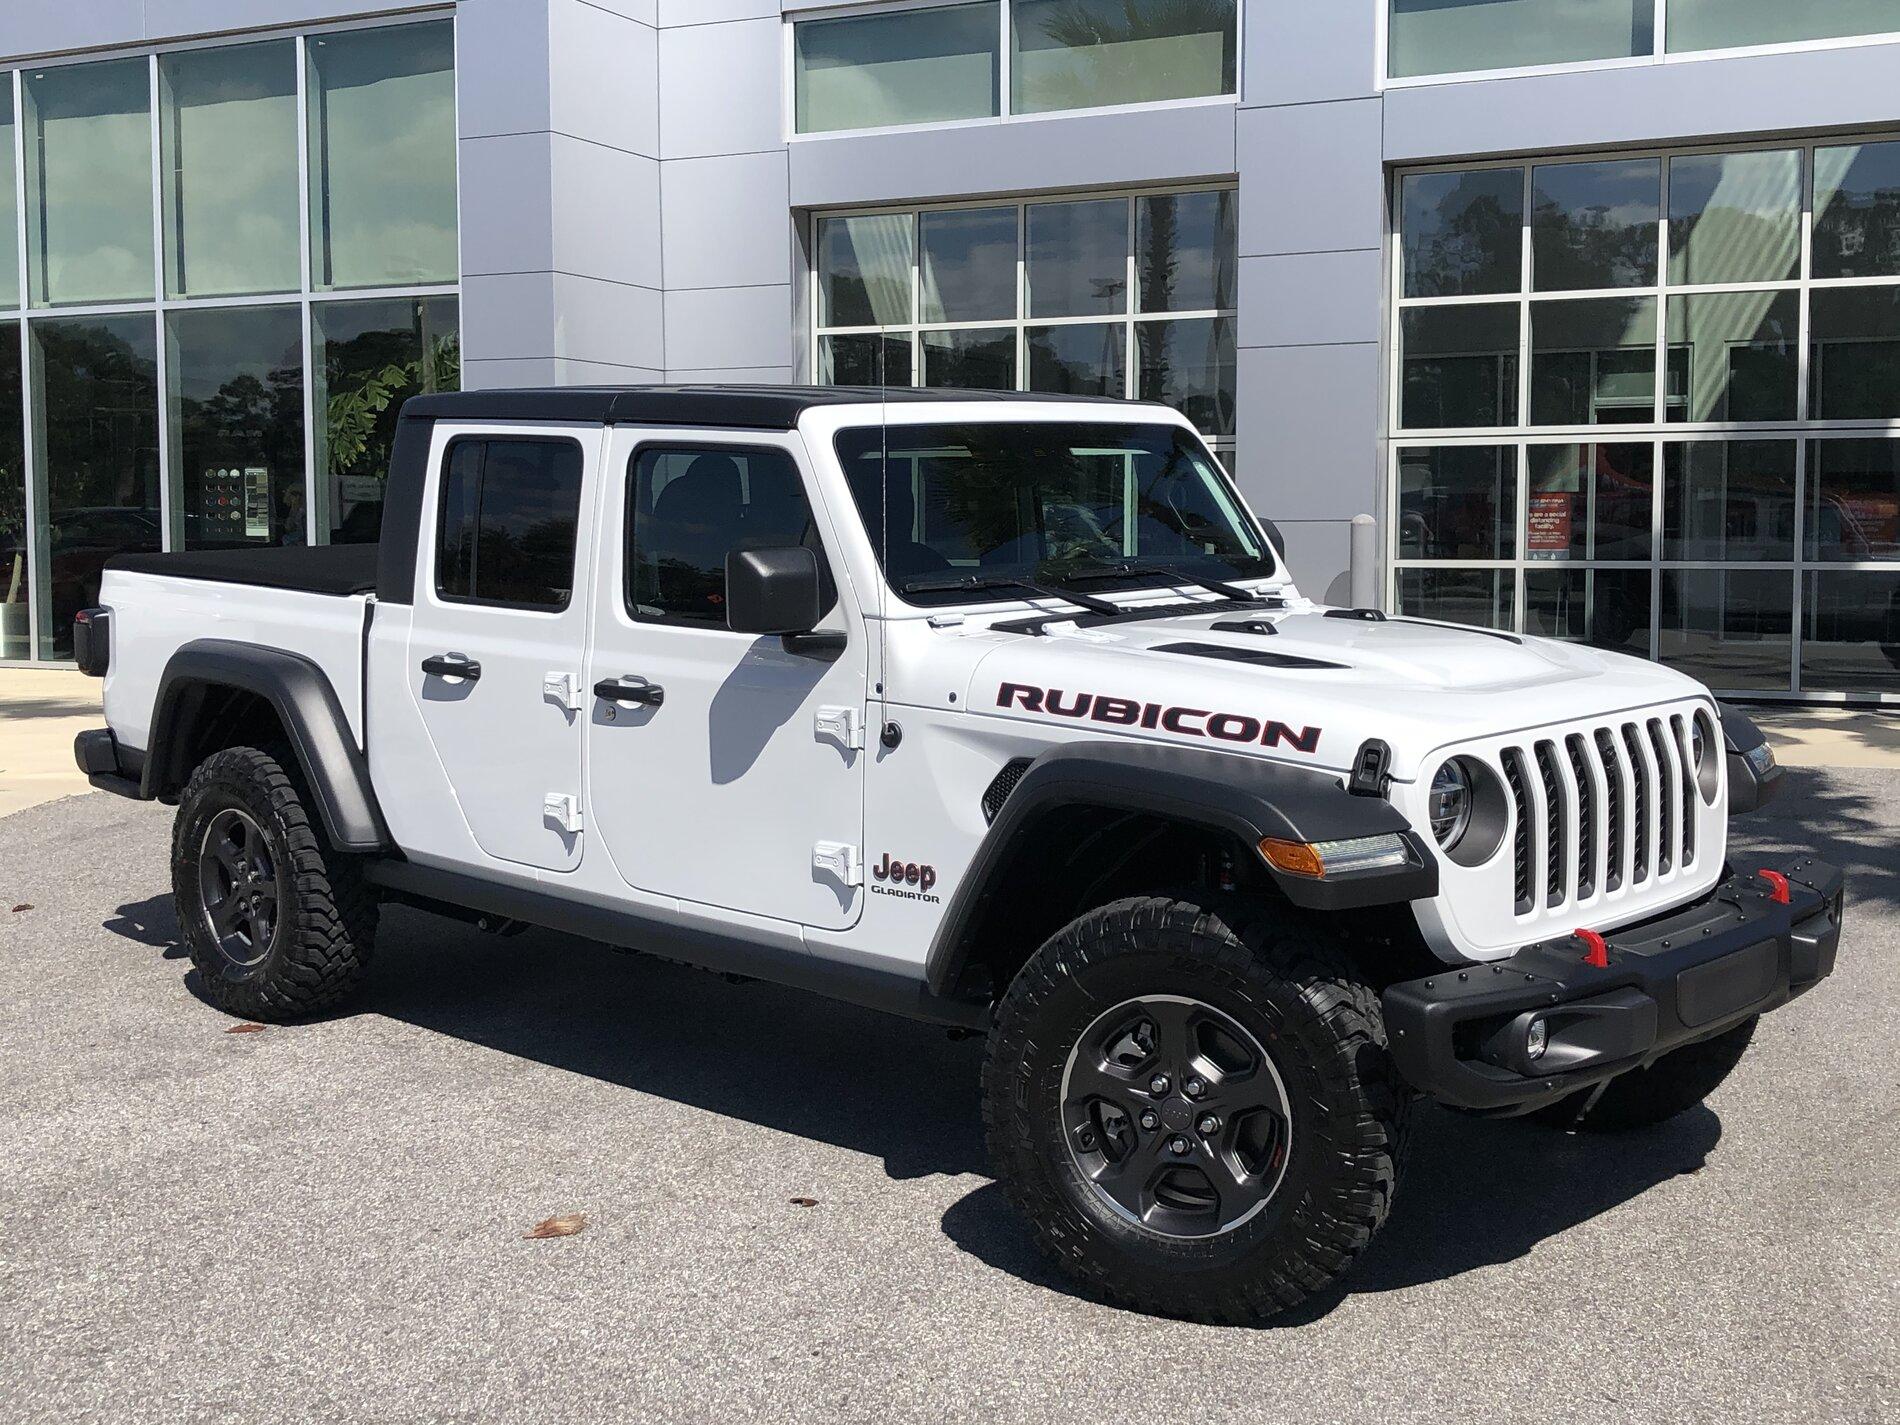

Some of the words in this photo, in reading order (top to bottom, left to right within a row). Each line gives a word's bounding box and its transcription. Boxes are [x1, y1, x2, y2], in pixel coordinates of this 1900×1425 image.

[996, 682, 1322, 754] RUBICON
[873, 852, 936, 893] Jeep
[871, 885, 940, 904] GLADIATOR
